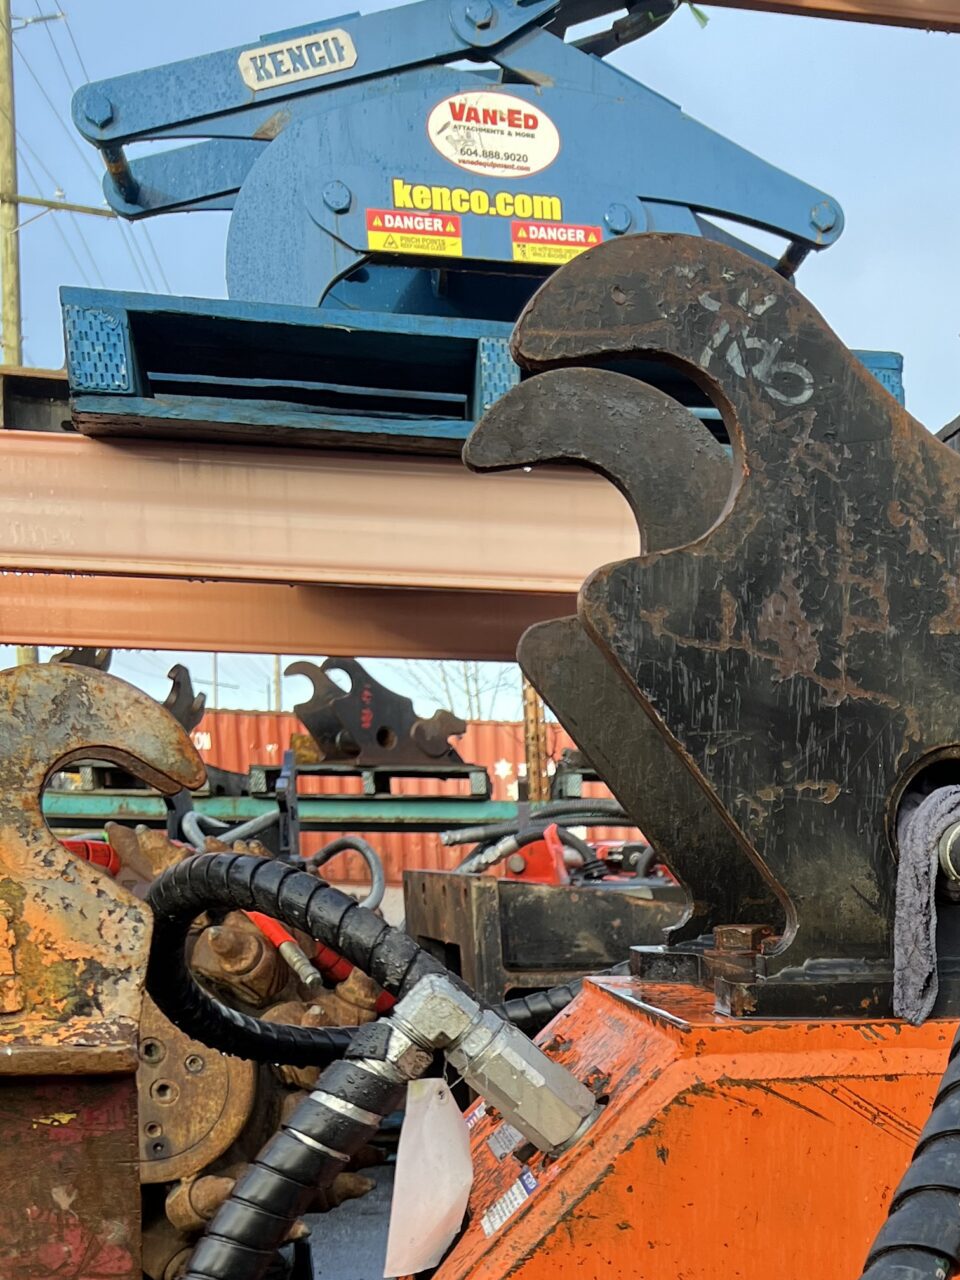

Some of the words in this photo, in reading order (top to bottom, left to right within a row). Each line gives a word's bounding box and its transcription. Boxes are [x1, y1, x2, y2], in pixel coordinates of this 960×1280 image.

[453, 124, 505, 136] ATTACHMENTS
[515, 131, 535, 139] MORE
[460, 147, 528, 163] 604.888.9020
[458, 158, 531, 171] vanedequipment.com
[392, 177, 562, 220] kenco.com
[384, 214, 443, 232] DANGER
[529, 225, 586, 242] DANGER
